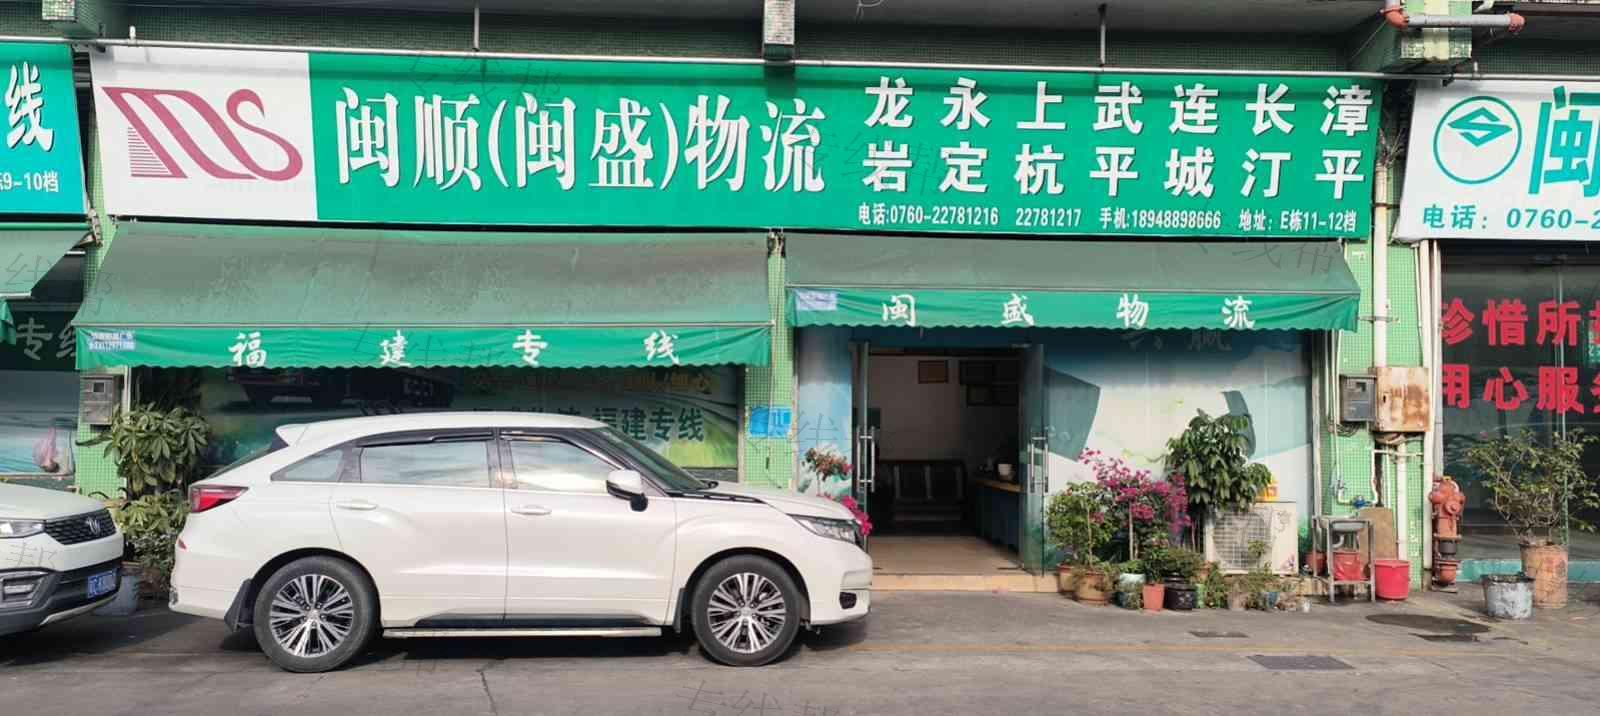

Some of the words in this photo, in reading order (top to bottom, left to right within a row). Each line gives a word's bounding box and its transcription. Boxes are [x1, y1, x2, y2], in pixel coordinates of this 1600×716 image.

[5, 61, 53, 151] 线
[334, 85, 826, 194] 闽顺(闽盛)物流
[0, 170, 59, 193] 9-10档
[858, 202, 999, 226] 电话:0760-22781216
[1015, 207, 1082, 227] 22781217
[1099, 206, 1222, 230] 手机:18948898666
[882, 293, 1256, 330] 闽盛物流
[1440, 297, 1600, 347] 珍惜所
[228, 330, 682, 370] 福建专线
